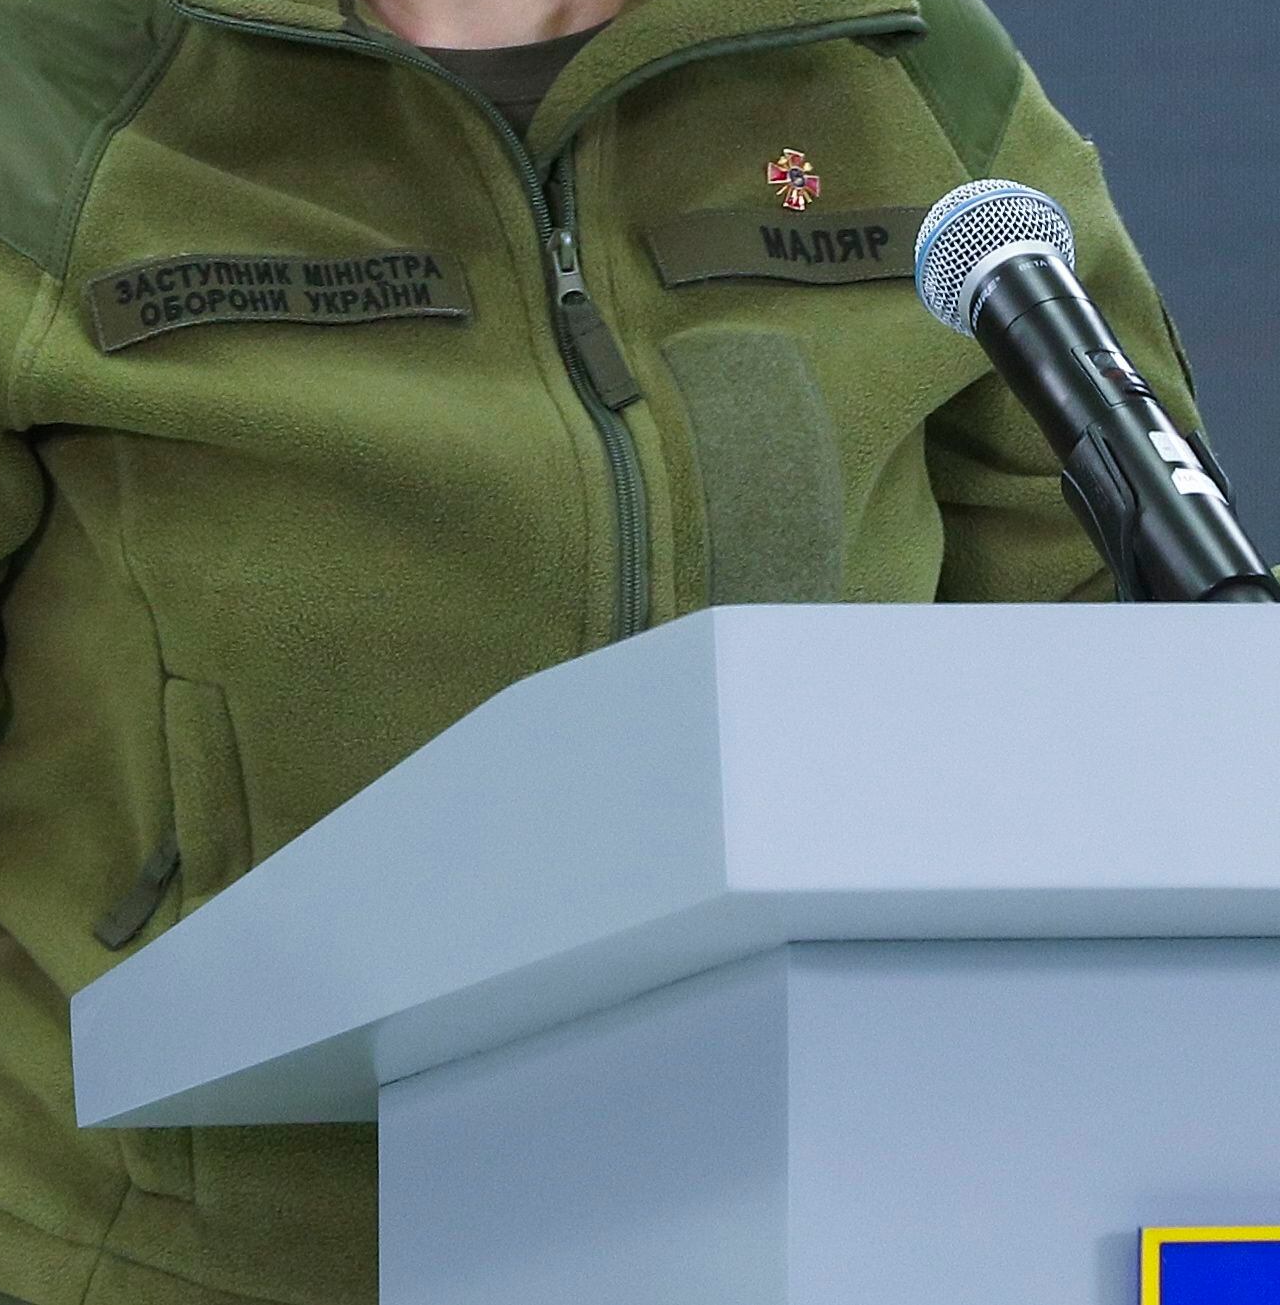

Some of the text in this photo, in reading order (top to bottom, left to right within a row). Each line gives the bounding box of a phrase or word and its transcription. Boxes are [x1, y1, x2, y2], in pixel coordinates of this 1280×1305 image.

[759, 225, 889, 263] МАЛЯР
[115, 255, 442, 304] ЗАСТУПНИК МІНІСТРА
[140, 281, 432, 326] ОБОРОНИ УКРАЇНИ
